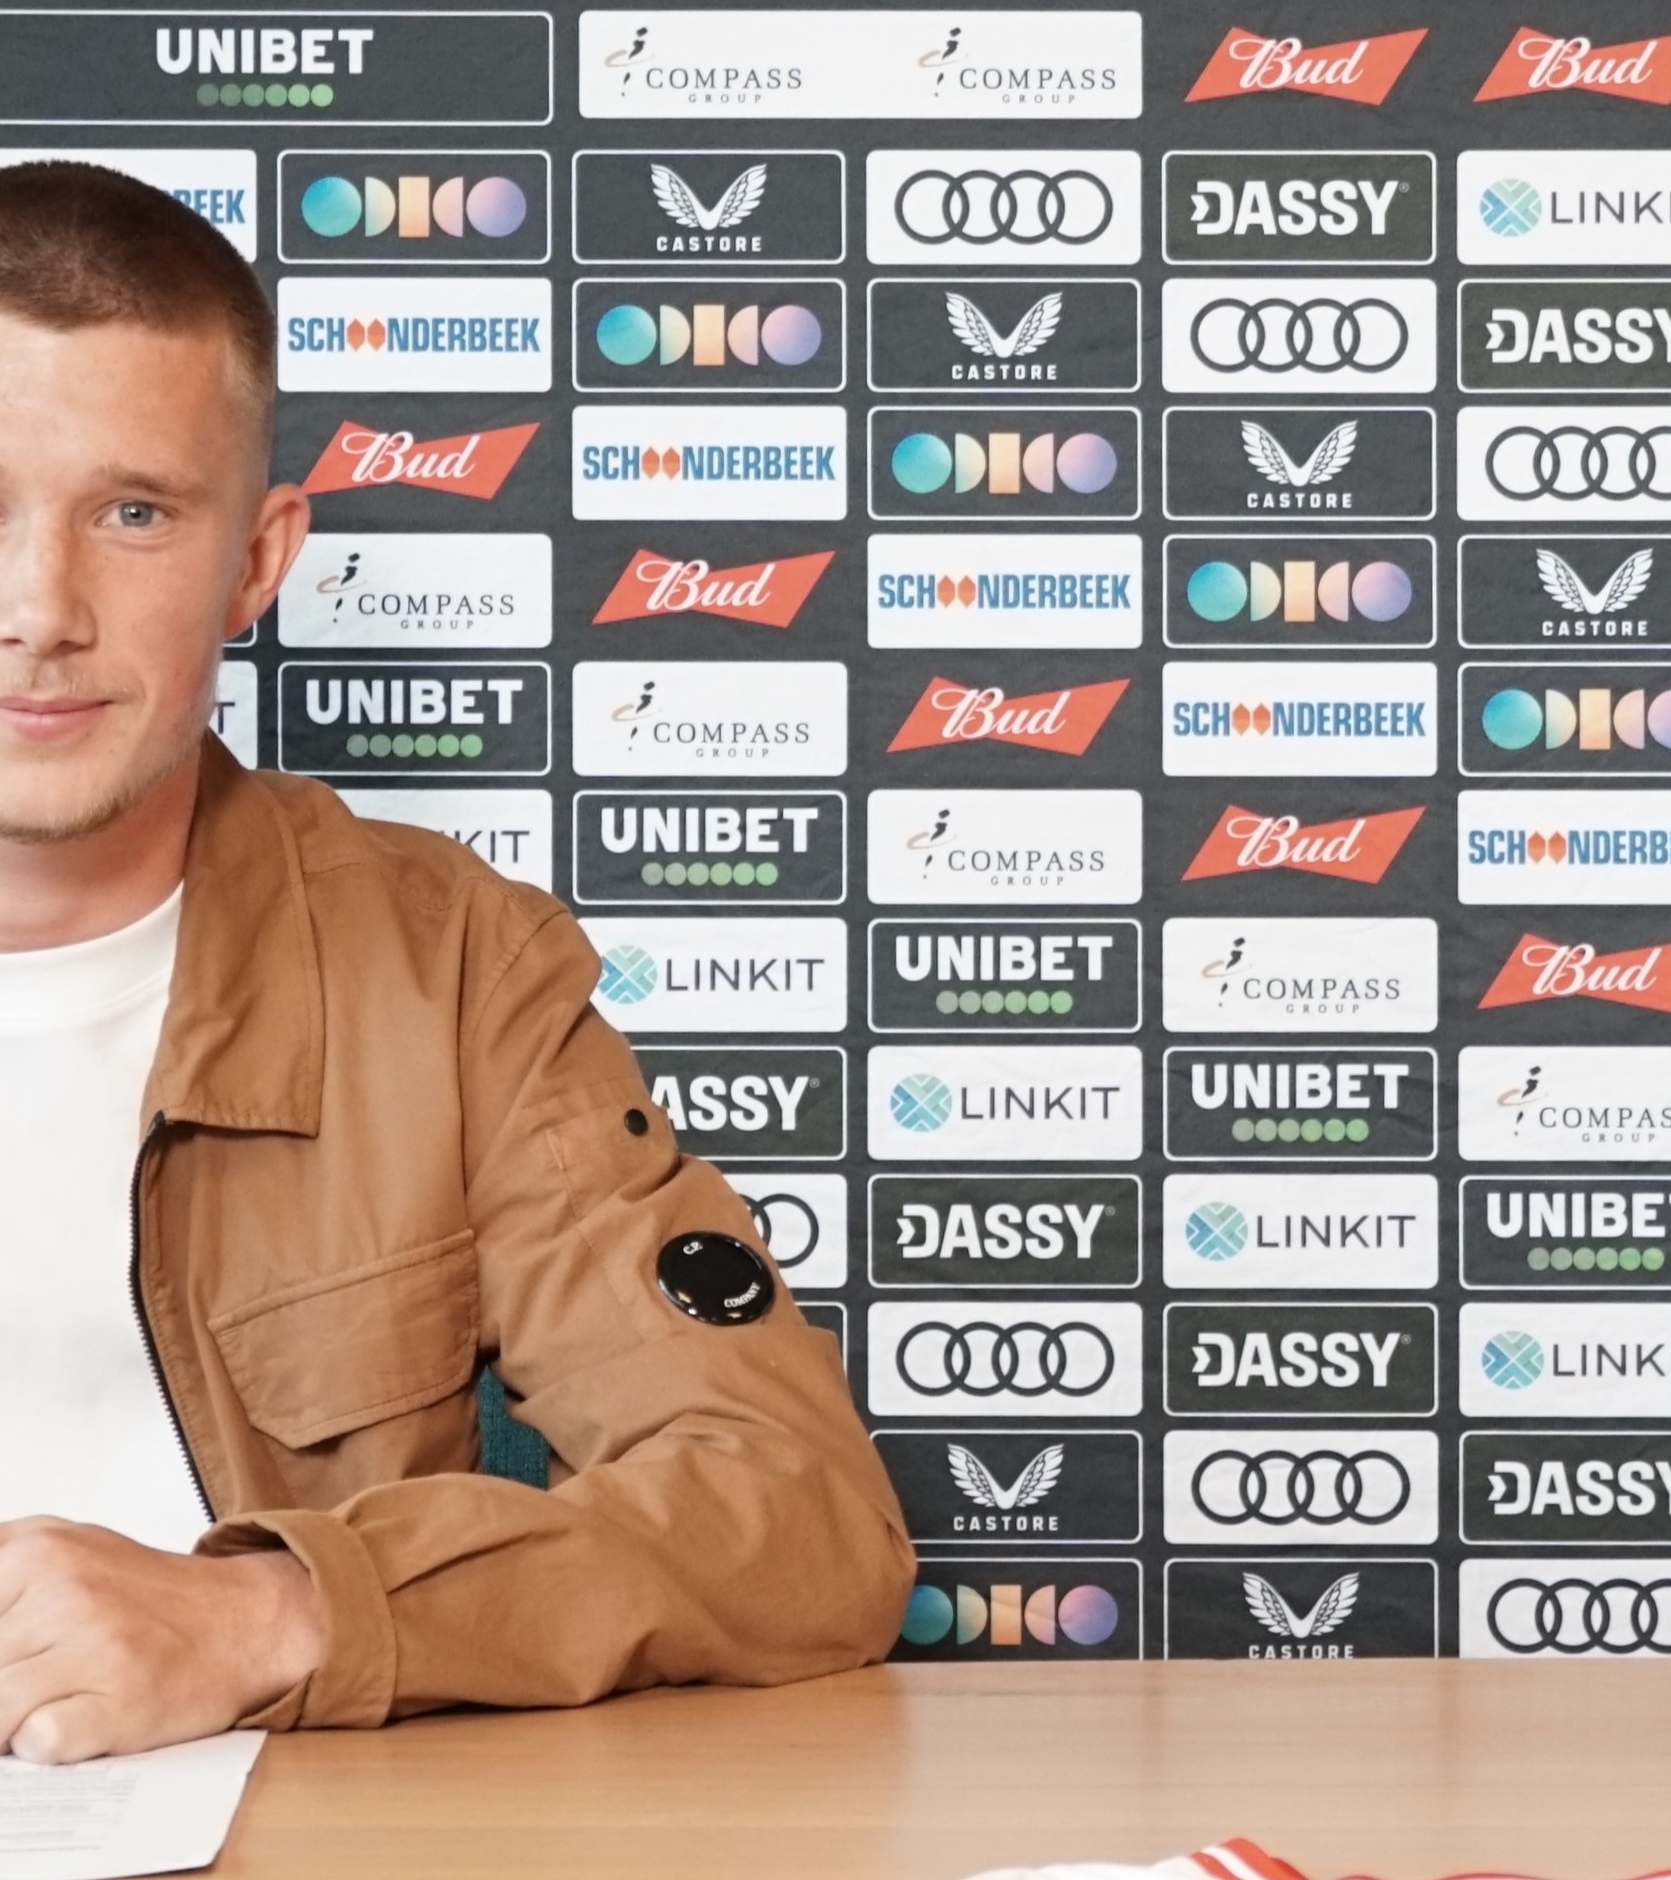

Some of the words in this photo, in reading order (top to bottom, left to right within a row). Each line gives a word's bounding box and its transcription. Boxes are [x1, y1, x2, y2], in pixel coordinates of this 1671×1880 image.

[157, 28, 373, 74] UNIBET
[1518, 37, 1658, 88] Bud
[1229, 38, 1369, 88] Bud
[646, 68, 801, 89] COMPASS
[960, 68, 1115, 89] COMPASS
[688, 93, 761, 103] GROUP
[1002, 94, 1075, 104] GROUP
[1551, 191, 1671, 224] LINK
[657, 236, 761, 252] CASTORE
[952, 364, 1056, 380] CASTORE
[342, 431, 481, 482] Bud
[1247, 493, 1352, 508] CASTORE
[636, 560, 775, 610] Bud
[358, 593, 513, 615] COMPASS
[400, 619, 473, 629] GROUP
[1542, 621, 1647, 636] CASTORE
[306, 679, 524, 724] UNIBET
[932, 687, 1071, 738] Bud
[653, 722, 809, 743] COMPASS
[696, 748, 769, 758] GROUP
[601, 807, 818, 853] UNIBET
[1227, 816, 1366, 866] Bud
[948, 850, 1104, 871] COMPASS
[991, 876, 1063, 886] GROUP
[896, 936, 1113, 981] UNIBET
[1522, 944, 1662, 995] Bud
[667, 959, 824, 991] LINKIT
[1243, 978, 1400, 999] COMPASS
[1286, 1004, 1359, 1014] GROUP
[1192, 1064, 1409, 1109] UNIBET
[651, 1076, 809, 1131] ASSY
[962, 1087, 1120, 1119] LINKIT
[1539, 1107, 1671, 1128] COMPAS
[1582, 1133, 1655, 1143] GROUP
[1487, 1193, 1671, 1238] UNIBE
[1257, 1215, 1416, 1248] LINKIT
[724, 1283, 760, 1308] COMPANY
[1553, 1344, 1665, 1376] LINK
[954, 1516, 1058, 1531] CASTORE
[1248, 1645, 1354, 1659] CASTORE
